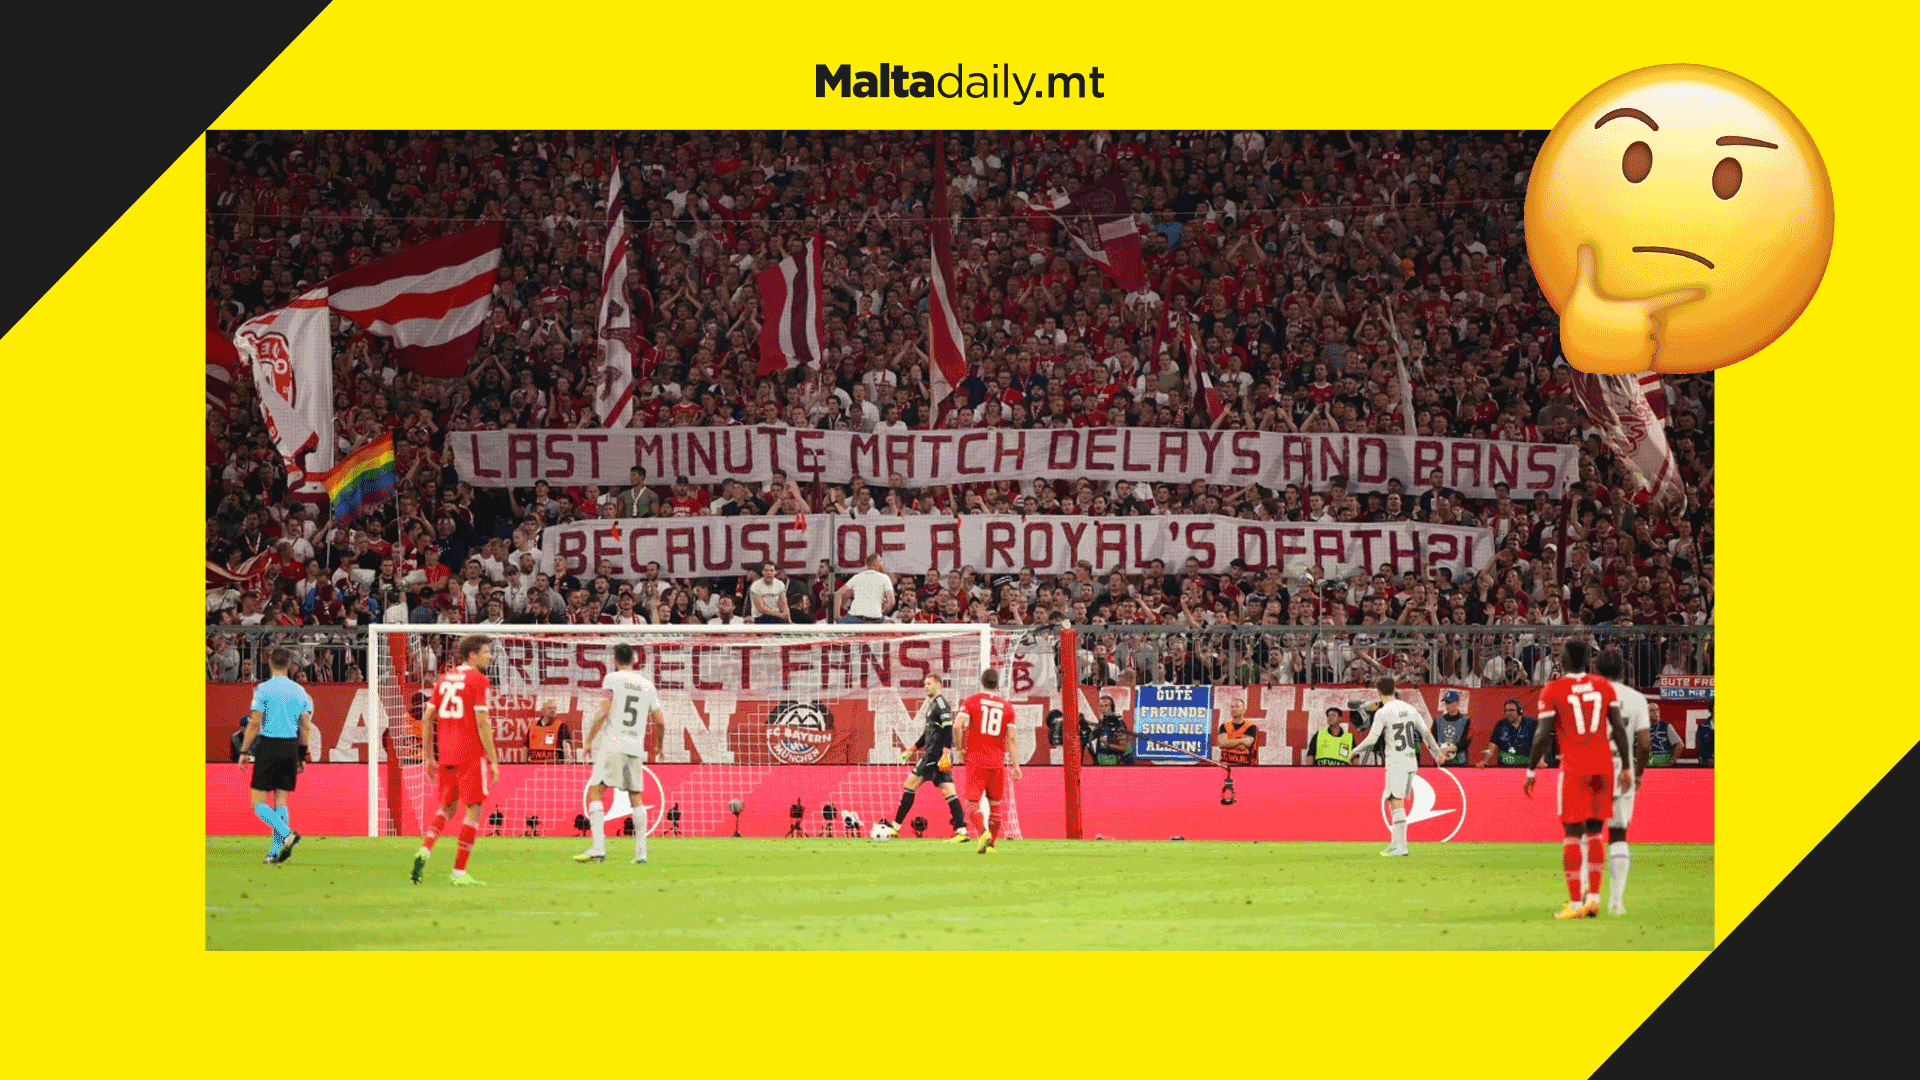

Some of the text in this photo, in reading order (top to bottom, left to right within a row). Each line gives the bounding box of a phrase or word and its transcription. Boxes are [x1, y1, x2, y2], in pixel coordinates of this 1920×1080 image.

[470, 426, 1557, 489] LAST MINUTE MATCH DELAYS AND BANS
[558, 521, 808, 576] BECAUSE
[837, 524, 905, 569] OF
[930, 523, 962, 569] A
[985, 520, 1215, 569] ROYAL'S
[782, 639, 952, 689] FANS!
[439, 682, 465, 718] 25
[1156, 689, 1193, 701] GUTE
[622, 695, 640, 727] 5
[981, 705, 1003, 736] 18
[1140, 707, 1206, 718] FREUNDE
[1567, 691, 1602, 735] 17
[766, 727, 832, 743] FC BAYERN
[1142, 723, 1203, 734] SIND NIE
[1392, 720, 1415, 751] 30
